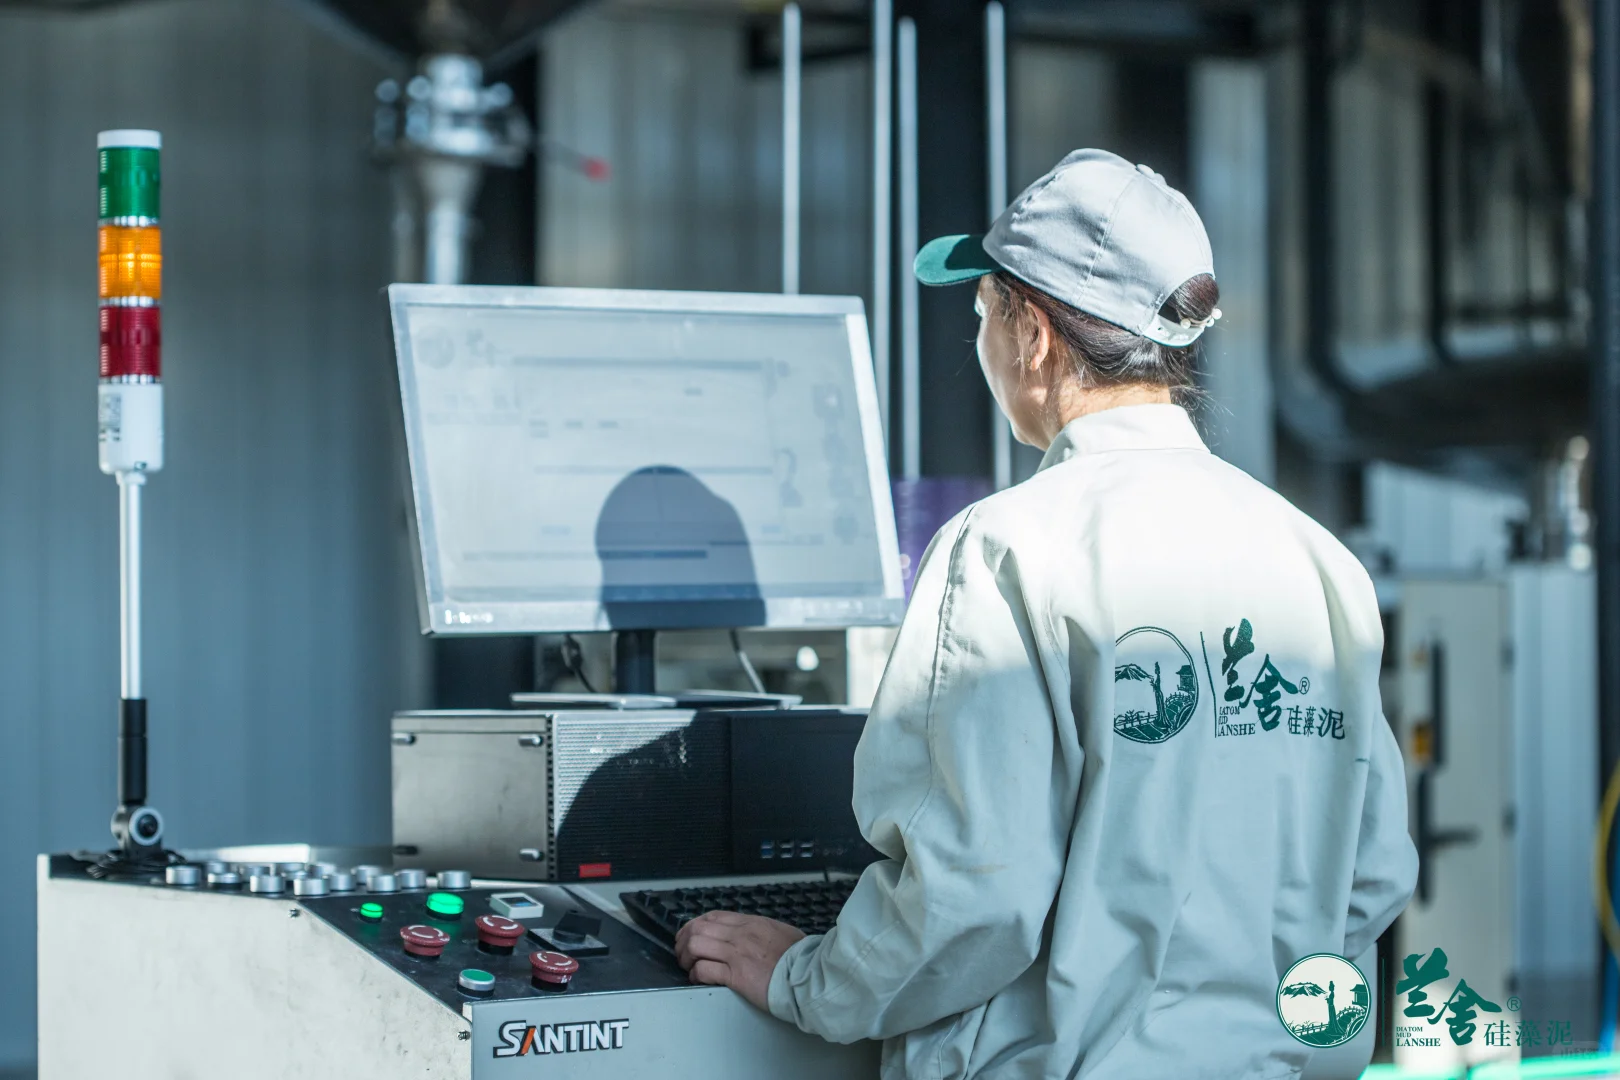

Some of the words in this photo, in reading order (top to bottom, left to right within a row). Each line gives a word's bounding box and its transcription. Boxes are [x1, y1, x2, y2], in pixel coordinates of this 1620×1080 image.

[1287, 705, 1346, 741] 硅藻泥
[493, 1018, 630, 1058] SANTINT
